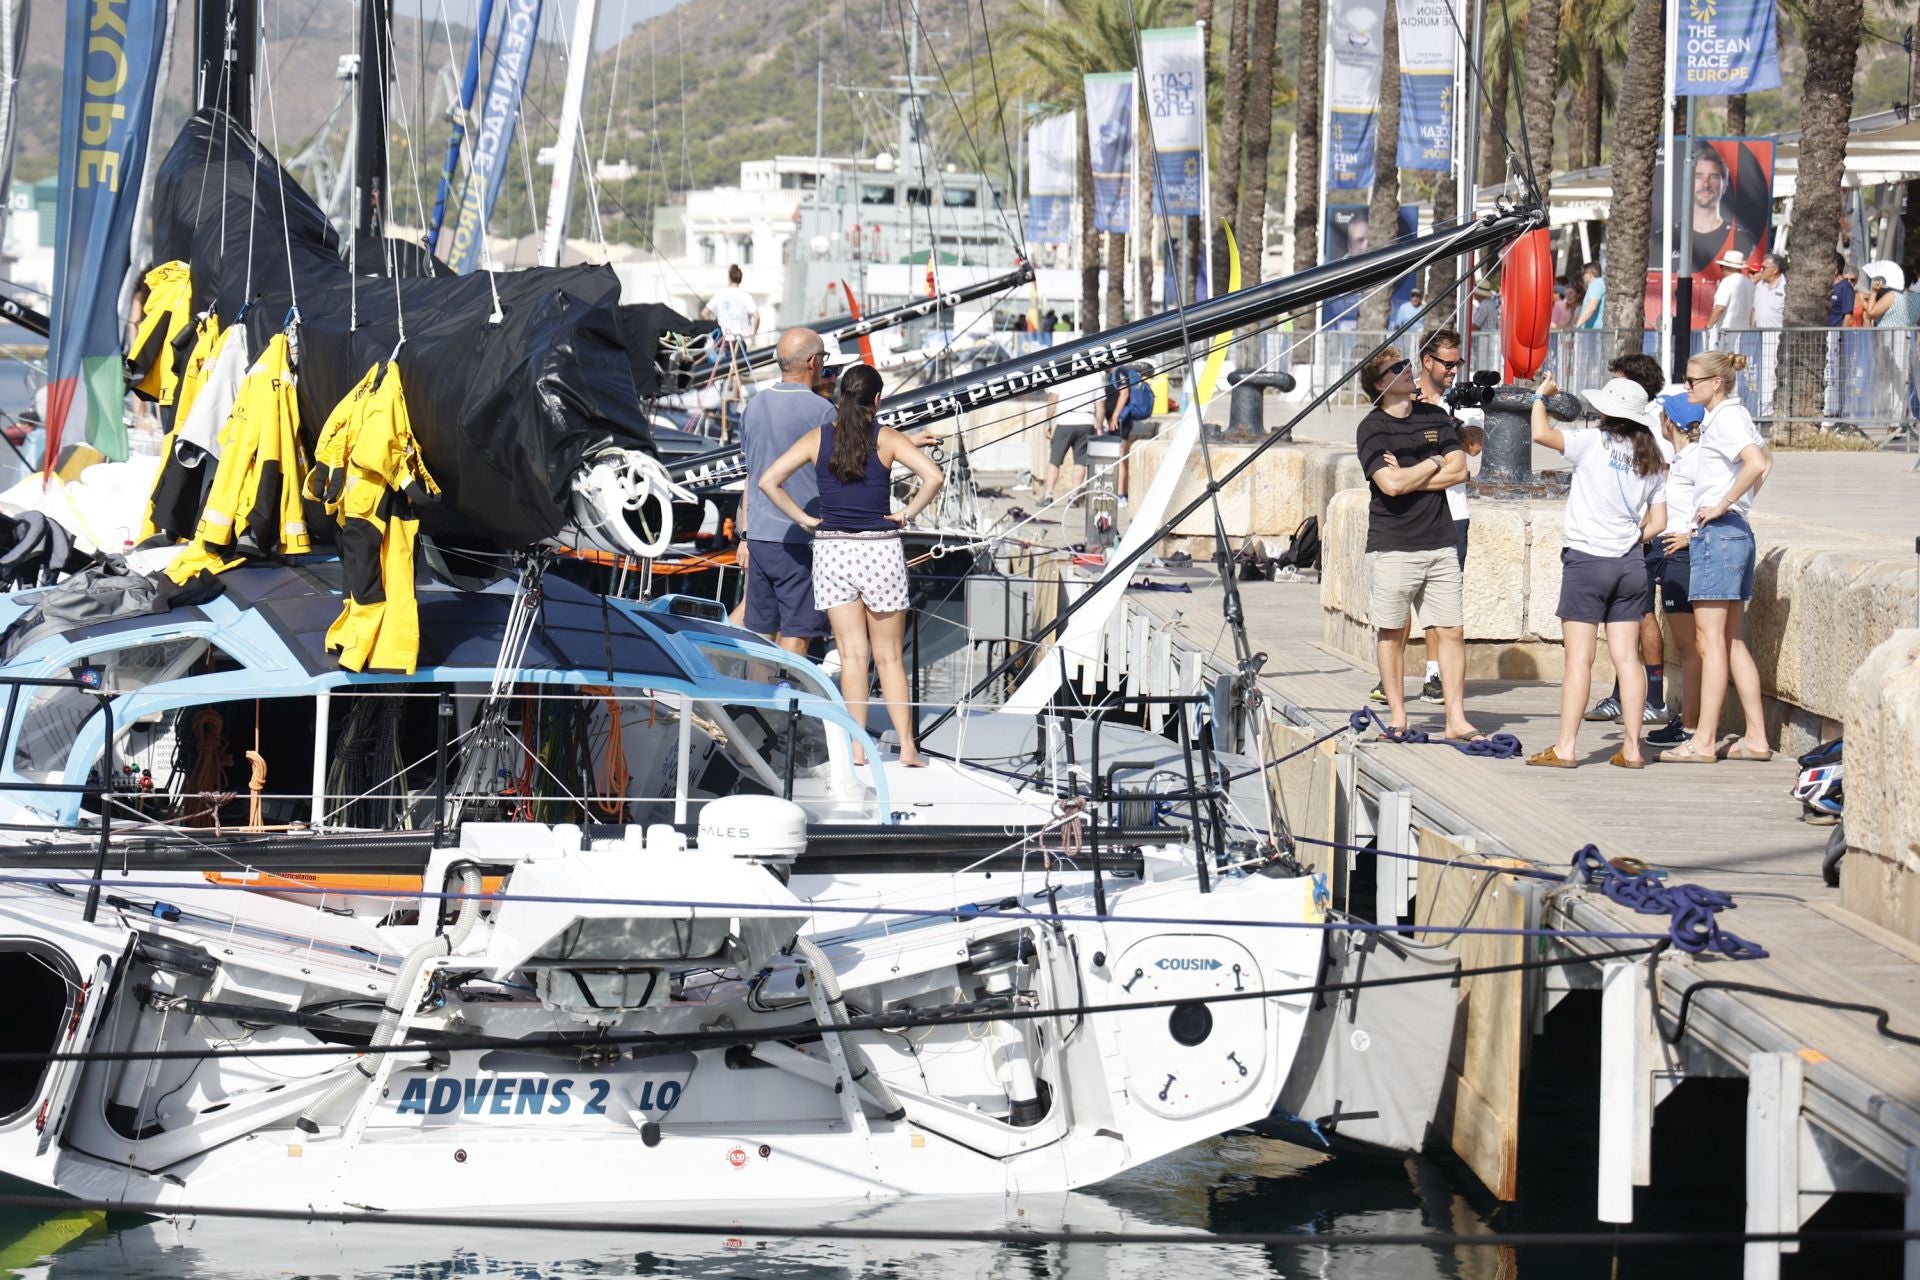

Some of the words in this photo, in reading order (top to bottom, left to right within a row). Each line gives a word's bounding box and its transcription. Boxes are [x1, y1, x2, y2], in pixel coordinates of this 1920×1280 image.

[1688, 25, 1717, 38] THE
[1687, 37, 1750, 54] OCEAN
[1688, 55, 1729, 68] RACE
[1688, 66, 1749, 82] EUROPE
[967, 338, 1133, 406] PEDALARE
[699, 825, 750, 838] HALES
[1160, 958, 1214, 971] COUSIN
[395, 1078, 574, 1115] ADVENS
[583, 1079, 611, 1115] 2
[639, 1081, 682, 1112] LO
